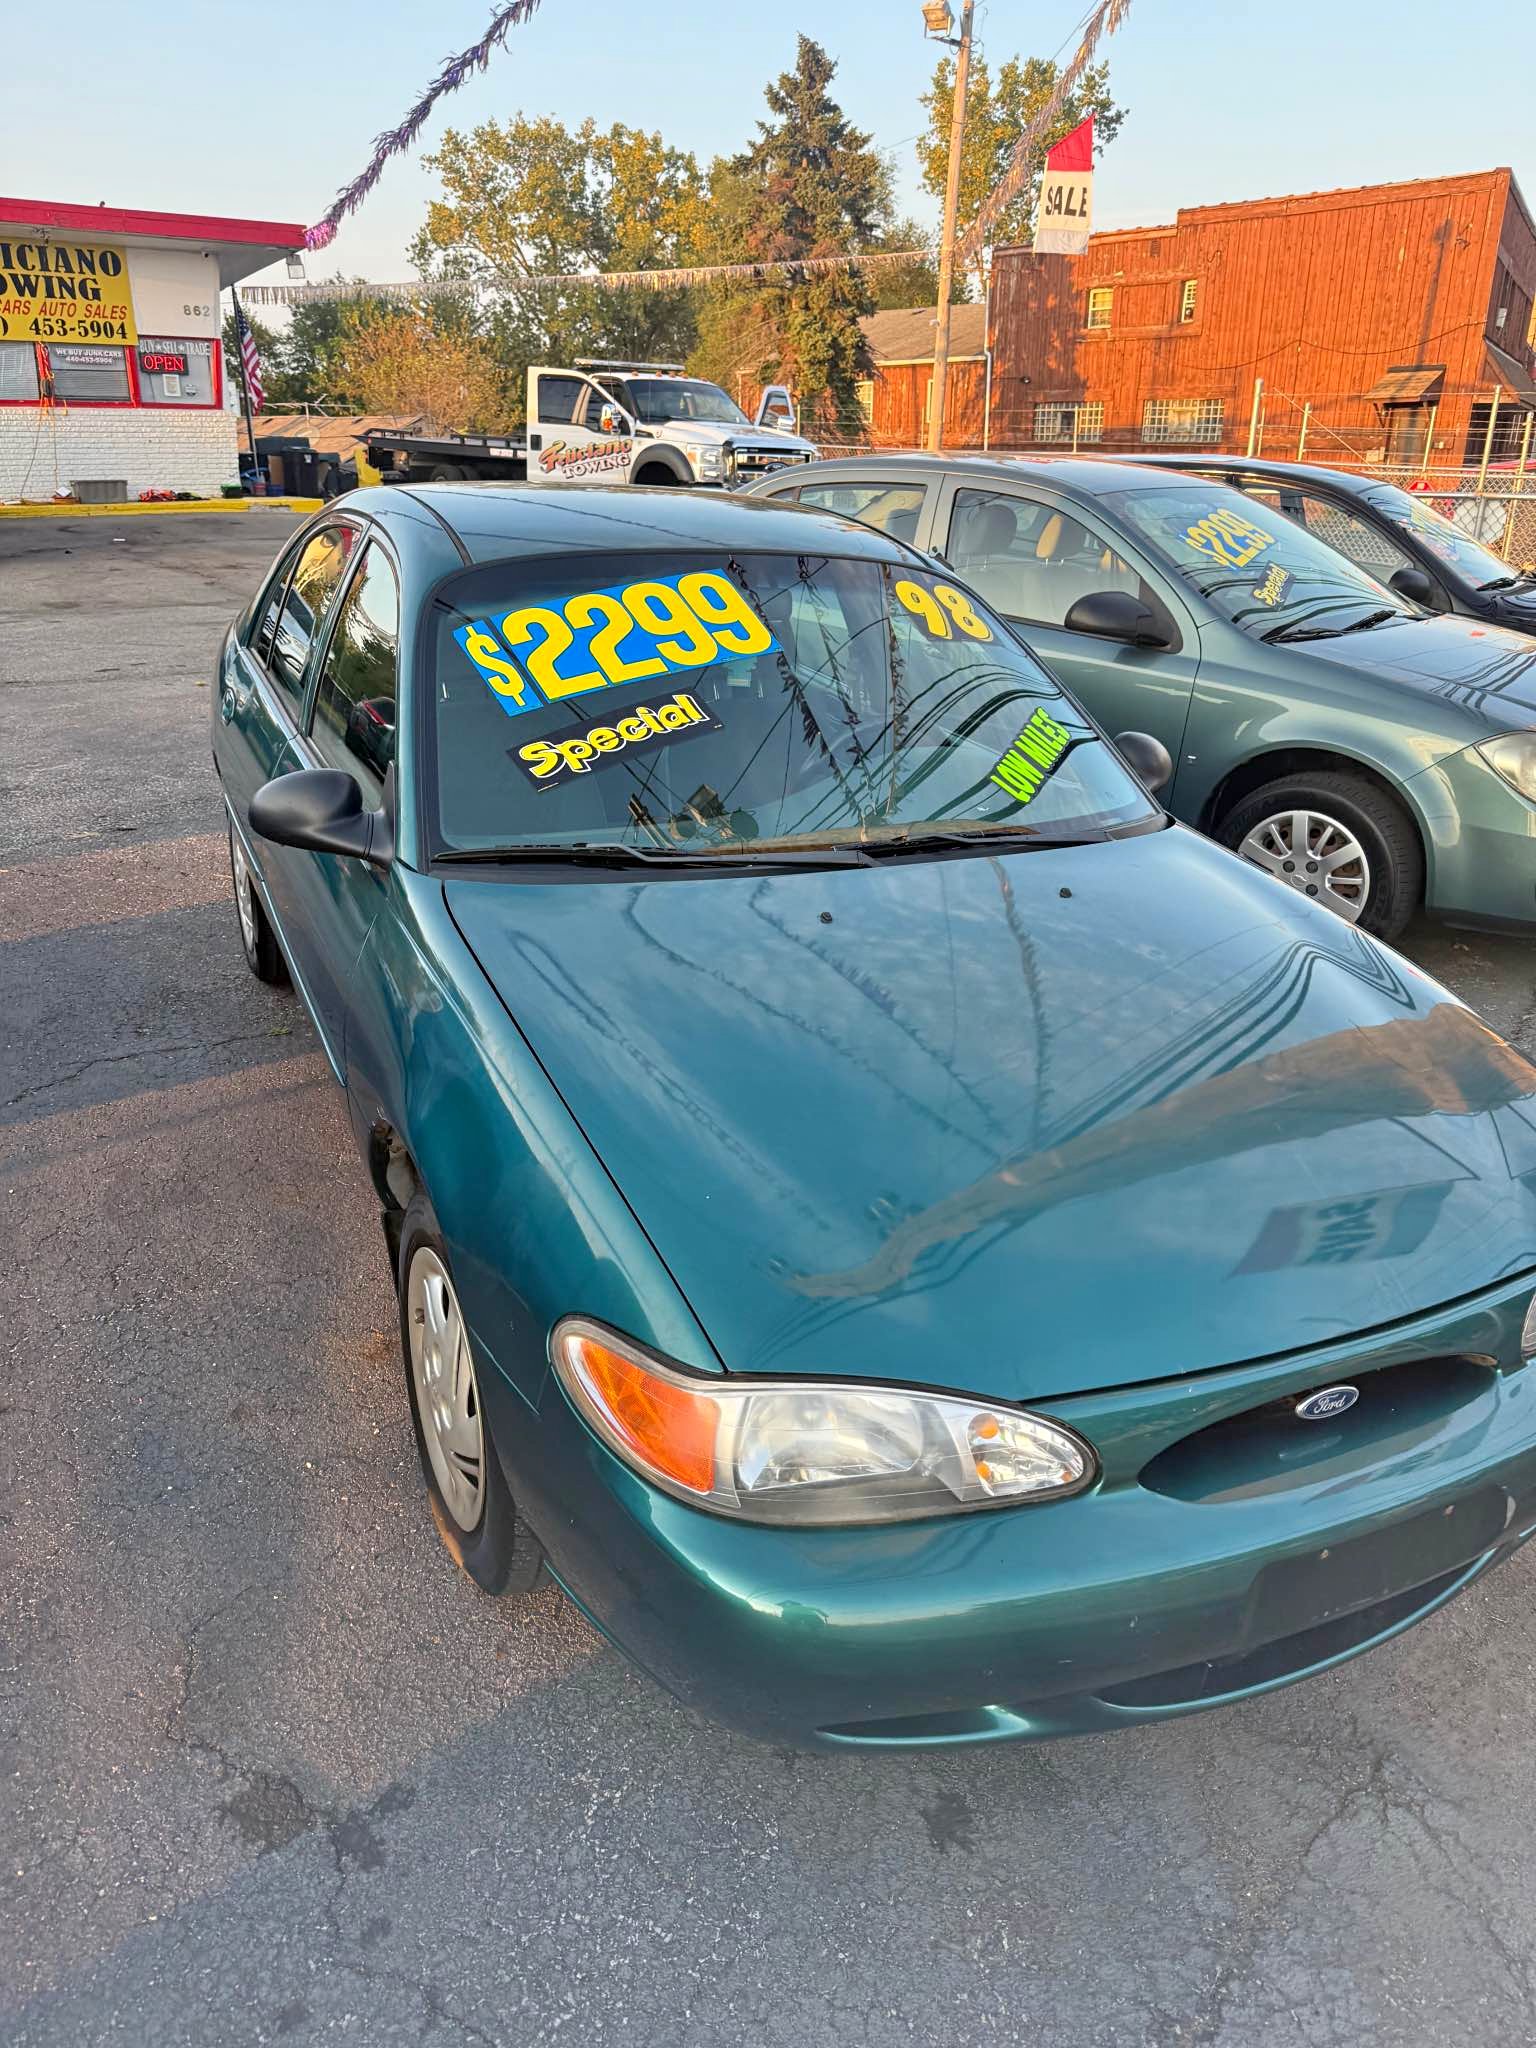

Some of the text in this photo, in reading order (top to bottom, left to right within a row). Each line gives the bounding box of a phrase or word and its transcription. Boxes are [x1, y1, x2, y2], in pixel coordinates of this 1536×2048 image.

[1045, 185, 1088, 217] SALE
[0, 299, 128, 320] ARS AUTO SALES
[183, 304, 211, 317] 862
[29, 317, 128, 339] 453-5904
[69, 348, 83, 357] BUY
[139, 339, 211, 356] BUY SELL TRADE
[144, 355, 184, 372] OPEN
[562, 454, 631, 479] TOWING
[1253, 562, 1290, 607] Special
[895, 580, 994, 642] 98
[465, 572, 772, 707] $2299
[518, 694, 710, 778] Special
[990, 706, 1071, 803] LOW MILES
[1313, 1393, 1347, 1414] Ford
